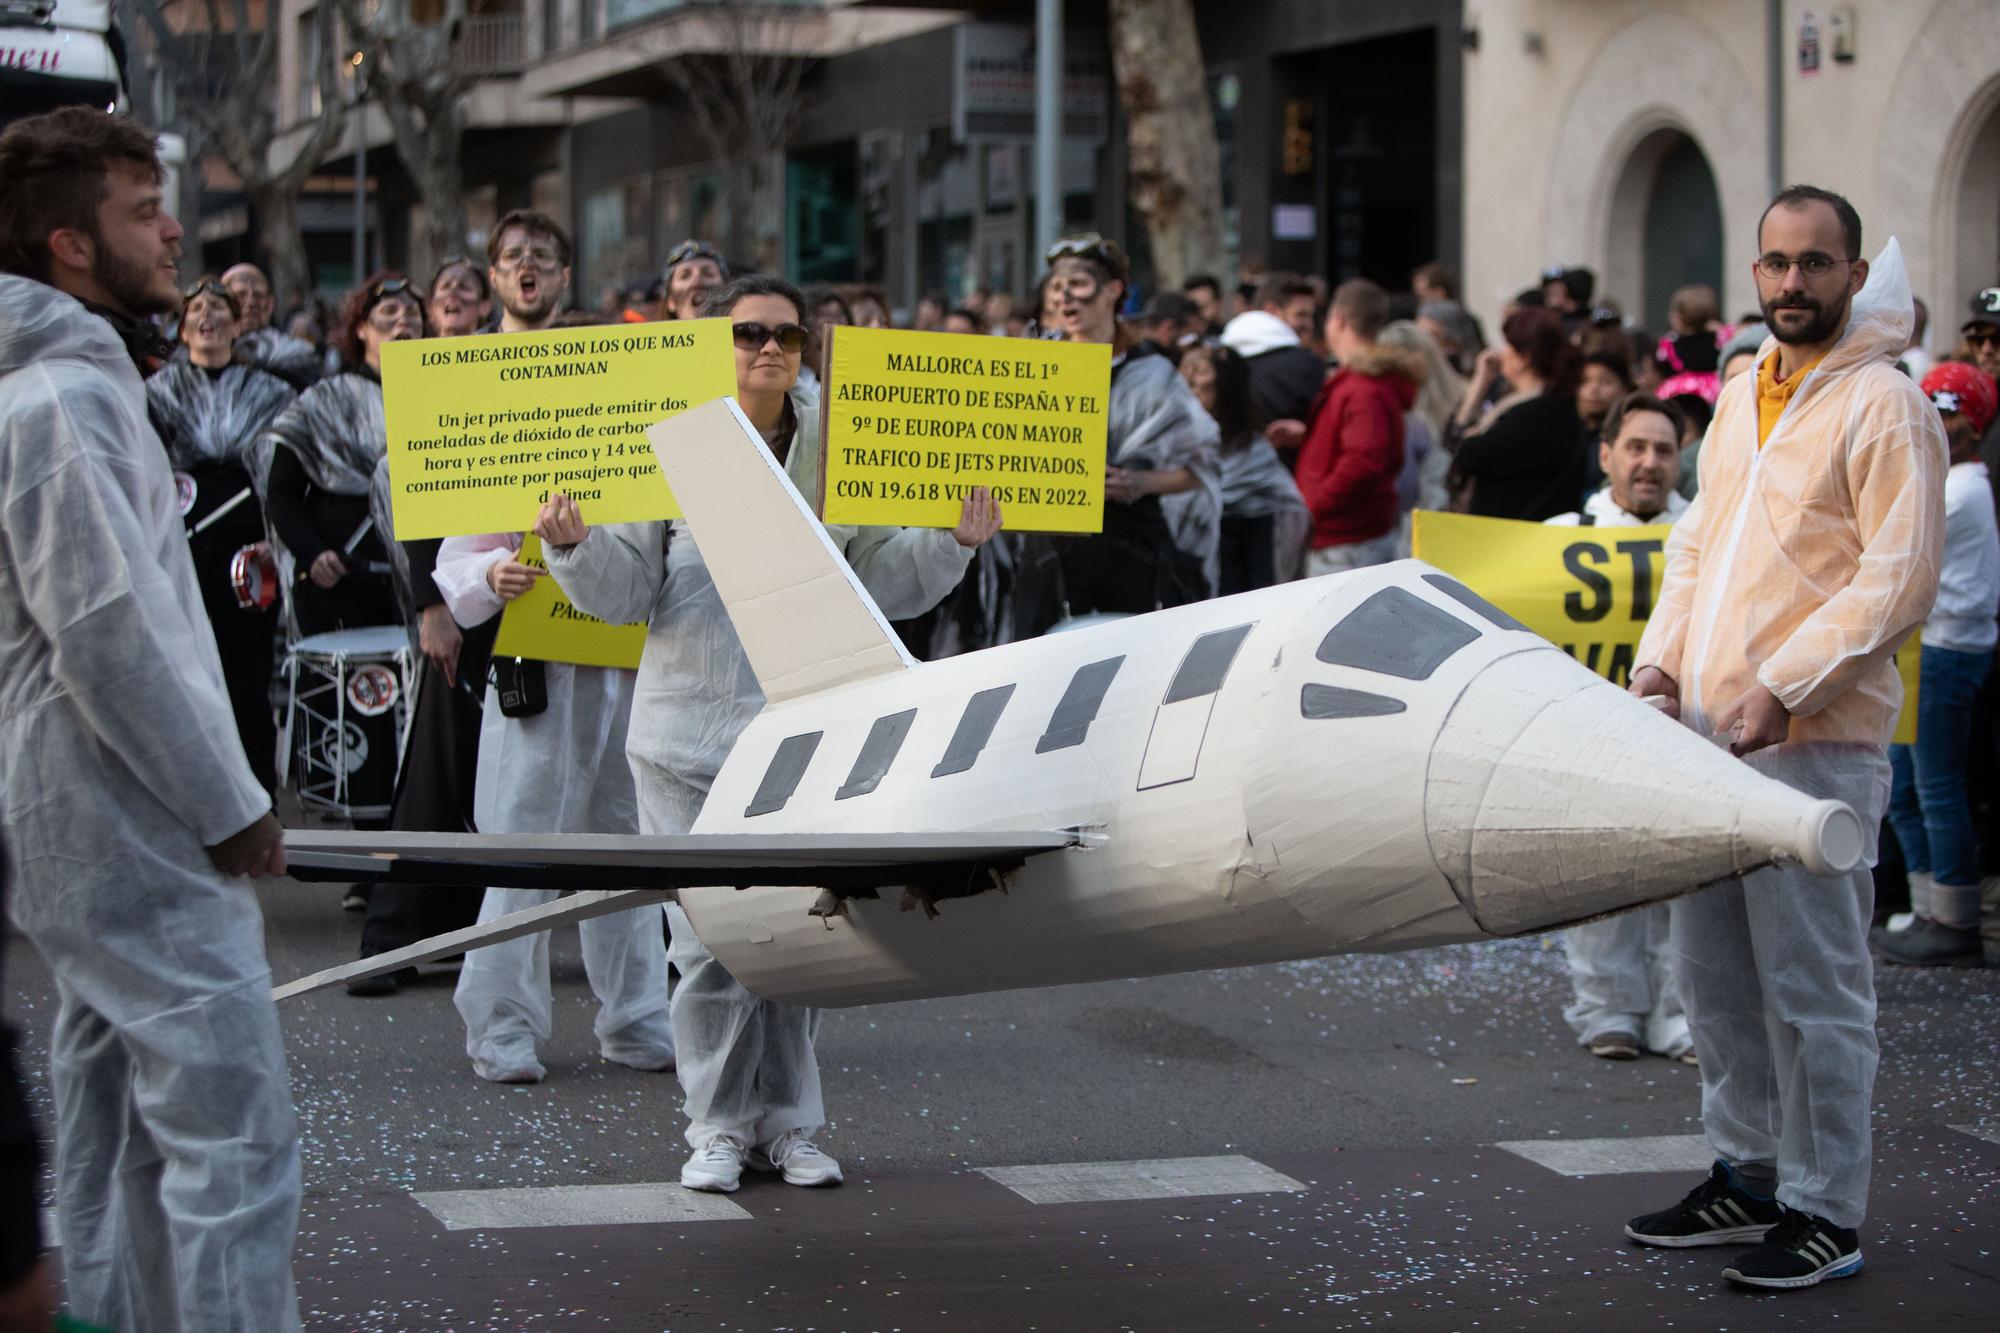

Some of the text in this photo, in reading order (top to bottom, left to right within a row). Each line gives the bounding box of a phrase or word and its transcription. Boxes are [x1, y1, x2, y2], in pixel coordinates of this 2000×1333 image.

[421, 333, 695, 367] LOS MEGARICOS SON LOS QUE MAS
[499, 360, 608, 382] CONTAMINAN
[887, 353, 1059, 380] MALLORCA ES EL 1º
[838, 383, 1100, 414] AEROPUERTO DE ESPAÑA Y EL
[438, 397, 688, 430] Un jet privado puede emitir dos
[407, 433, 486, 452] toneladas
[489, 431, 509, 445] de
[512, 426, 572, 443] dióxido
[575, 424, 595, 438] de
[852, 416, 1082, 444] 9º DE EUROPA CON MAYOR
[424, 457, 462, 471] hora
[466, 457, 476, 472] y
[479, 455, 496, 467] es
[499, 452, 543, 465] entre
[546, 447, 588, 461] cinco
[591, 447, 601, 462] y
[606, 442, 625, 457] 14
[842, 447, 1089, 476] TRAFICO DE JETS PRIVADOS,
[405, 464, 657, 494] contaminante por pasajero que
[836, 480, 1091, 506] CON 19.618 VUEOS EN 2022.
